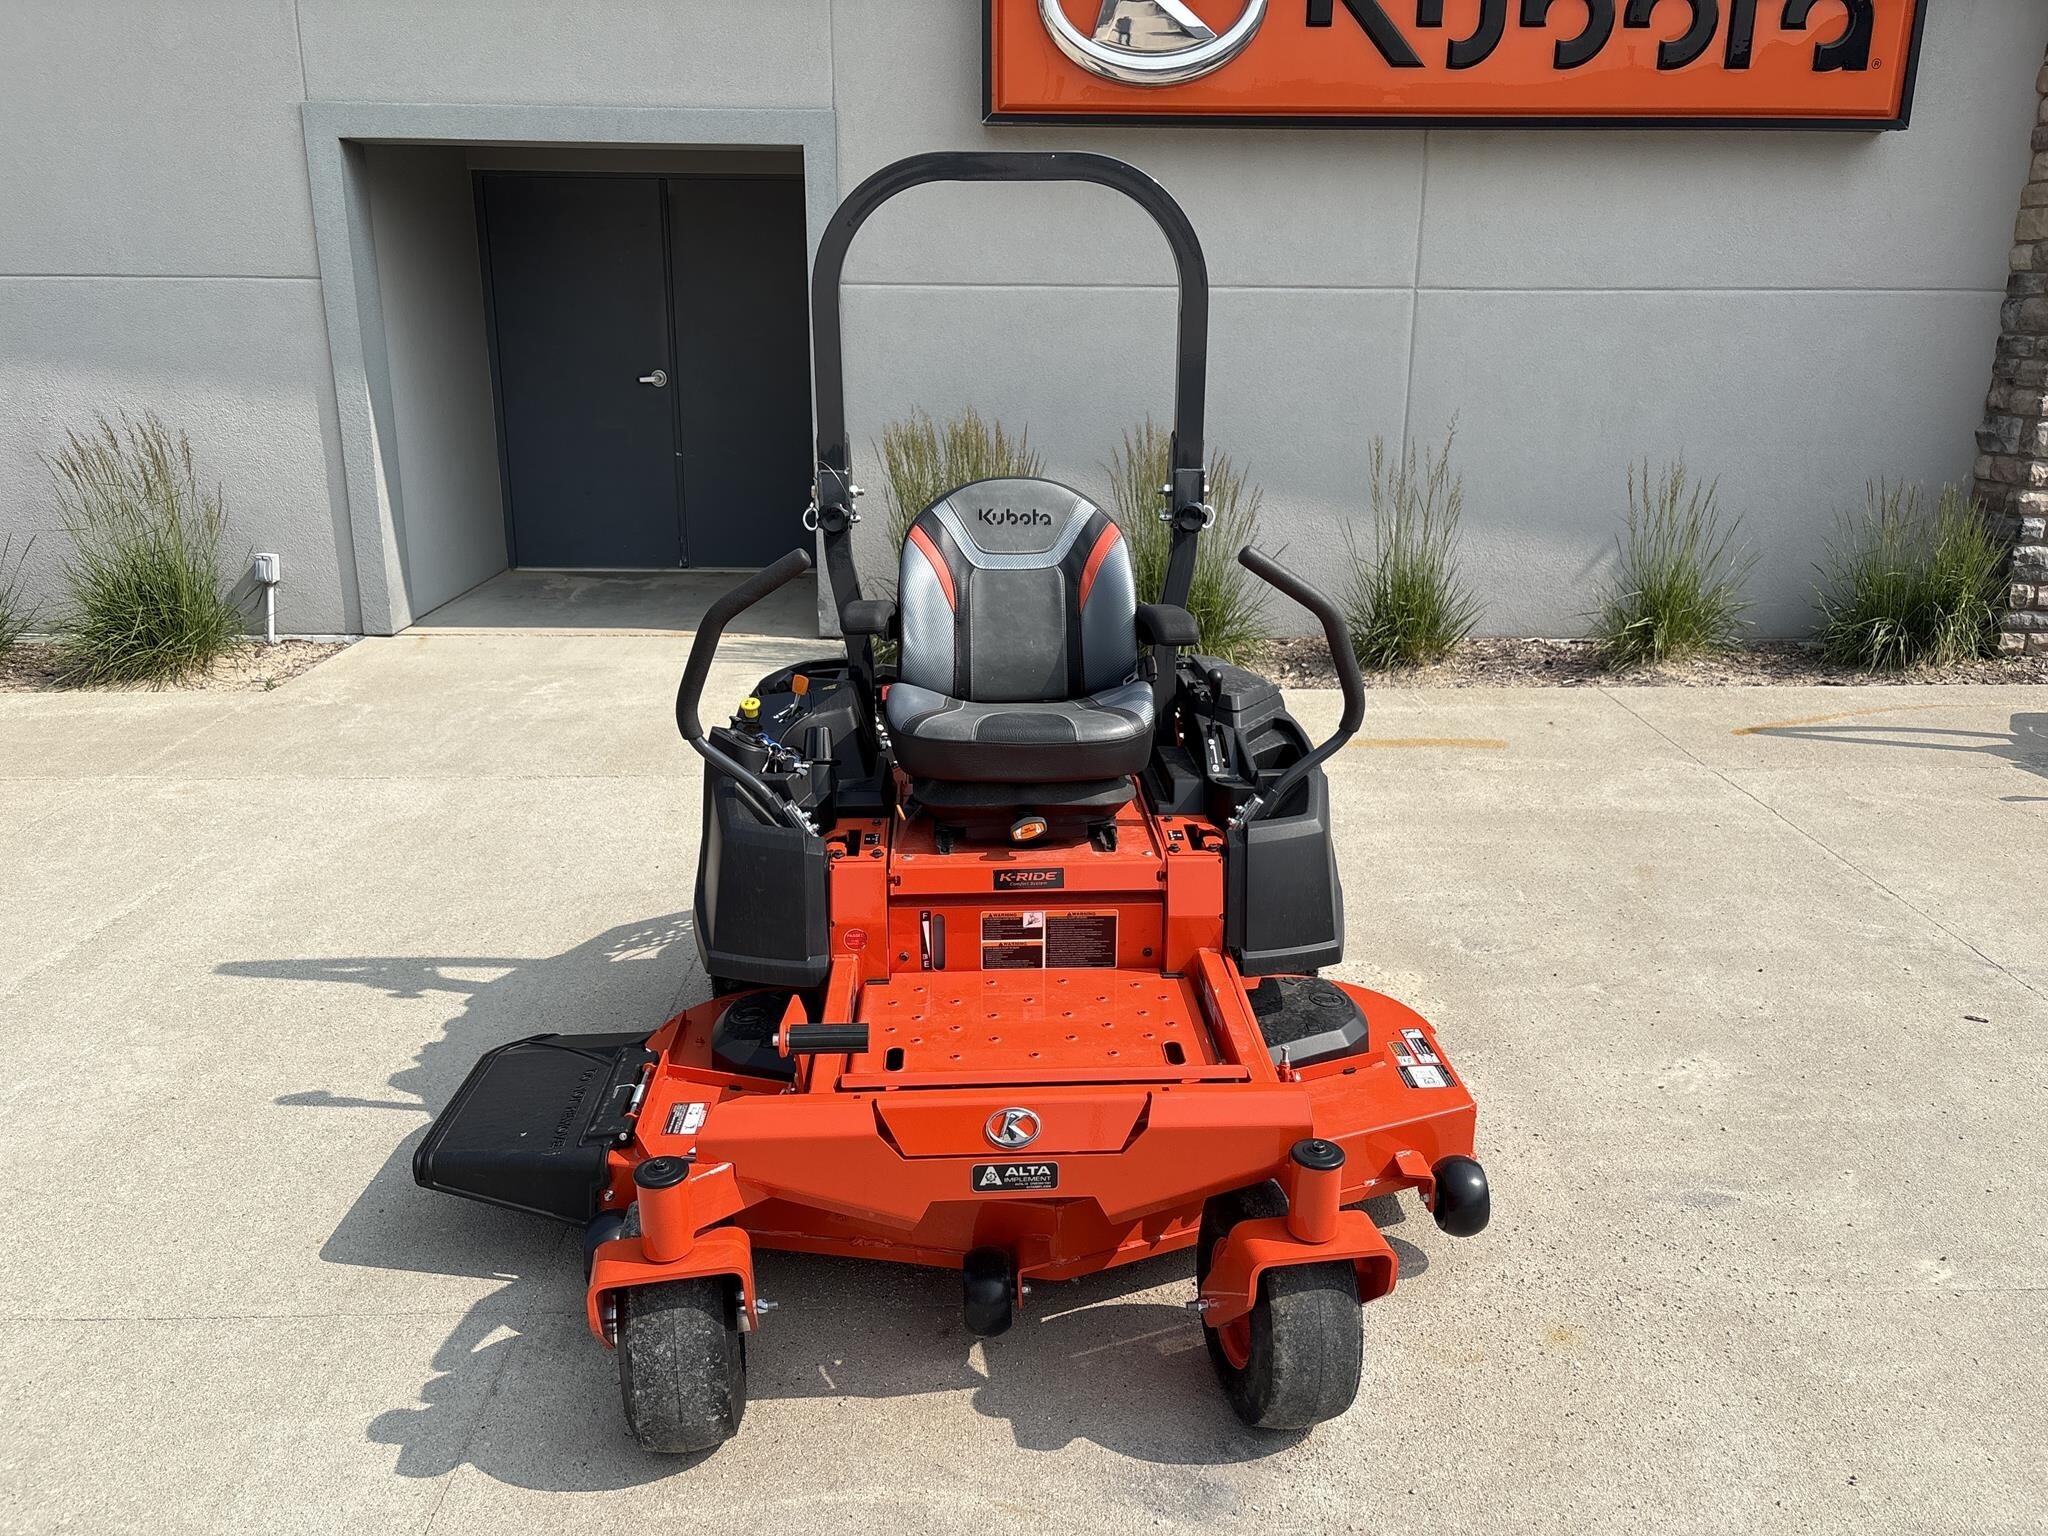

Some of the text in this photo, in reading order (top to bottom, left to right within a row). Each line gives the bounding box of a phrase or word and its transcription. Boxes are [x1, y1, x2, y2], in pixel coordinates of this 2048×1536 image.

[978, 508, 1052, 526] Kubota
[999, 872, 1058, 882] K-RIDE
[922, 912, 929, 920] F
[923, 960, 930, 968] E
[1005, 1166, 1051, 1176] ALTA
